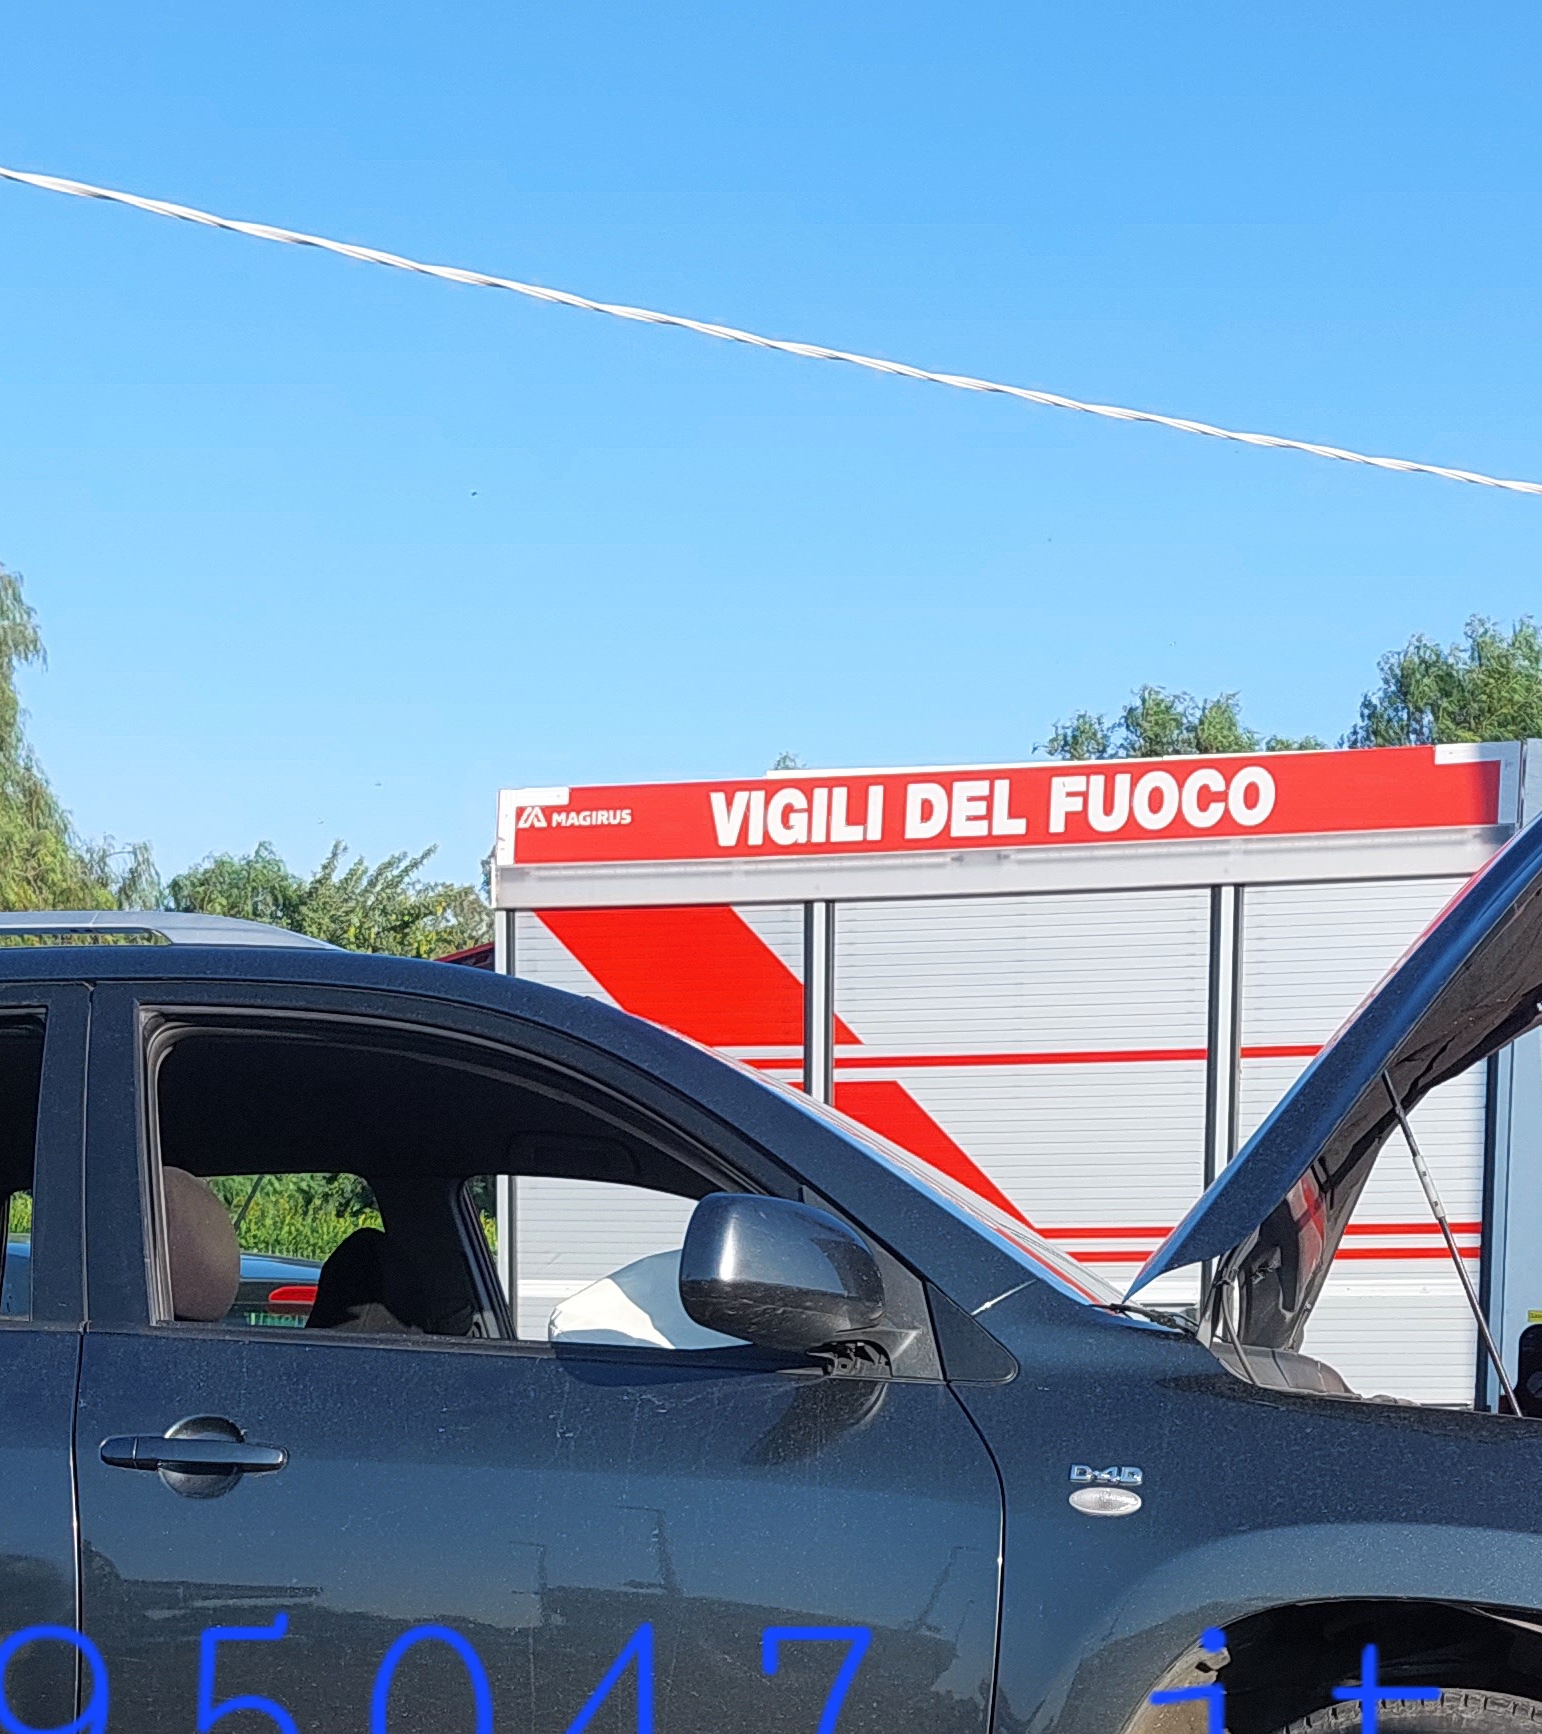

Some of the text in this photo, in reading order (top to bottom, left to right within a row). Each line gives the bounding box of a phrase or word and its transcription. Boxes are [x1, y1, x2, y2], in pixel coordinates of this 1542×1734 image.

[710, 766, 1276, 847] VIGILI DEL FUOCO
[551, 809, 632, 828] MAGIRUS
[1069, 1464, 1143, 1486] D-4D
